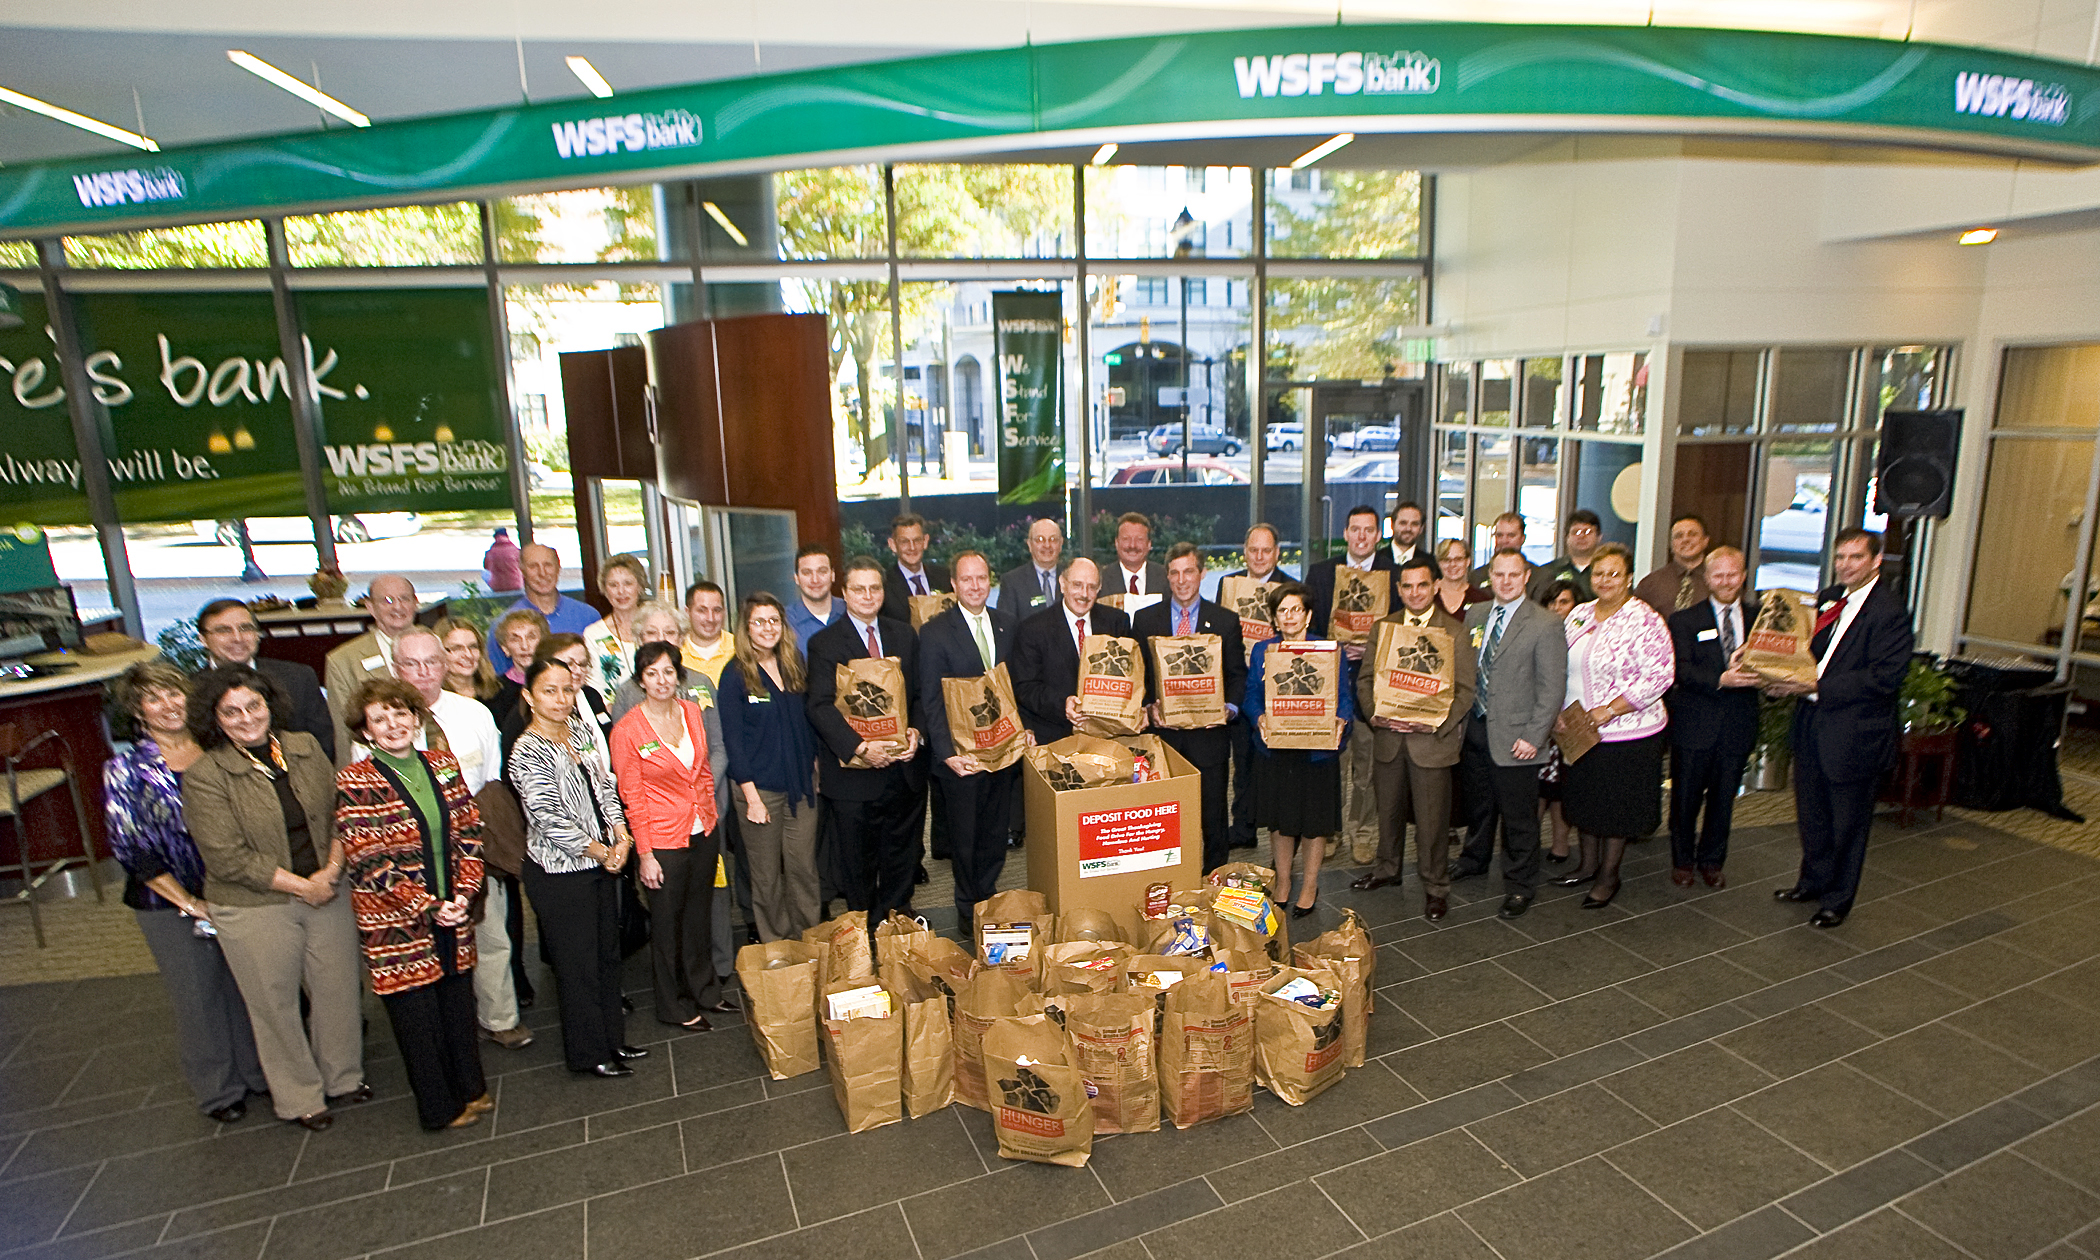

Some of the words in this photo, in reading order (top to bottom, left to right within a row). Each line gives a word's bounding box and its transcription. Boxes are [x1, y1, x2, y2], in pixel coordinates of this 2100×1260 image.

[1234, 51, 1363, 98] WSFS
[1367, 58, 1432, 93] bank
[1955, 71, 2034, 120] WSFS
[551, 113, 646, 159] WSFS
[645, 116, 698, 149] bank
[72, 168, 146, 208] WSFS
[998, 319, 1037, 334] WSFS
[157, 330, 370, 408] bank.
[1002, 354, 1031, 375] We
[1005, 378, 1048, 400] Stand
[1004, 402, 1030, 424] For
[107, 449, 166, 482] will
[171, 448, 220, 481] be.
[323, 441, 441, 478] WSFS
[442, 443, 501, 473] bank
[1085, 679, 1132, 692] HUNGER
[1165, 678, 1213, 691] HUNGER
[1391, 671, 1438, 689] HUNGER
[1274, 700, 1323, 710] HUNGER
[1082, 812, 1122, 826] DEPOSIT
[1124, 808, 1153, 821] FOOD
[1154, 804, 1178, 817] HERE
[1082, 860, 1107, 870] WSFS
[1077, 1042, 1085, 1059] 1
[1117, 1046, 1127, 1062] 2
[1223, 1034, 1233, 1051] 2
[1002, 1107, 1061, 1131] HUNGER
